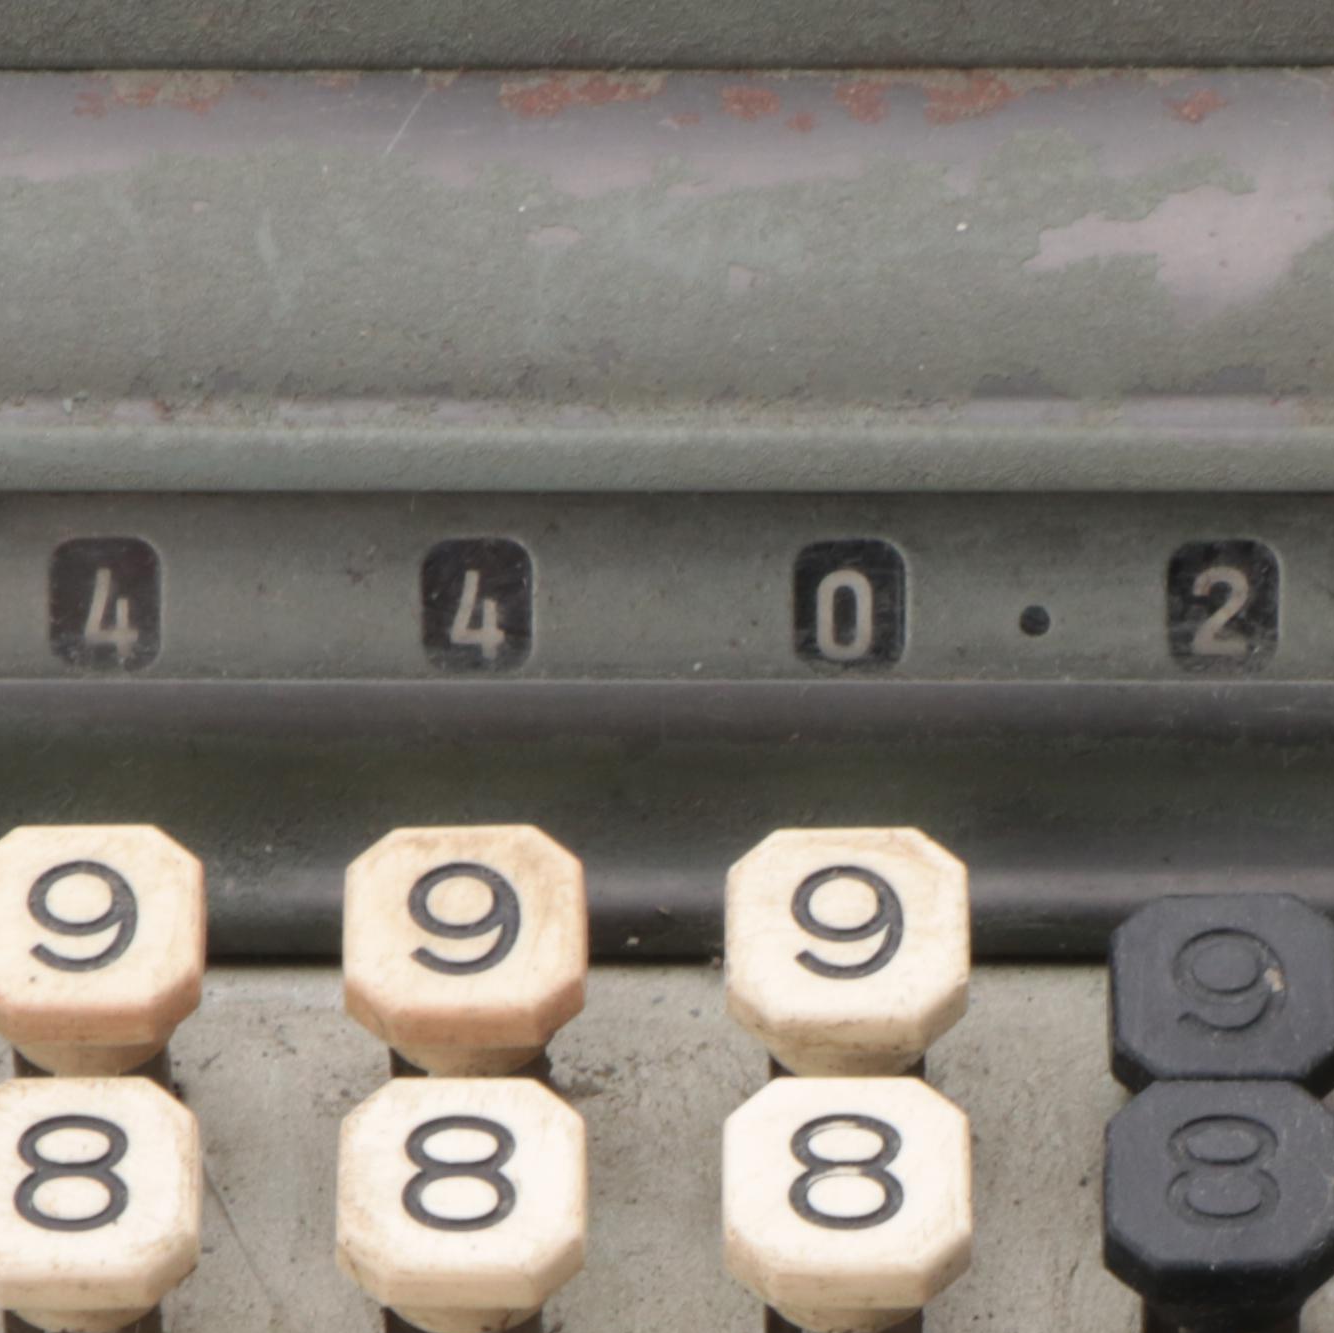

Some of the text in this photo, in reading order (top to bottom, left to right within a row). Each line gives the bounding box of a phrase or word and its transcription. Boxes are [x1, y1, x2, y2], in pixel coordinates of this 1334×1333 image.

[83, 567, 139, 661] 4
[450, 569, 507, 661] 4
[814, 567, 873, 663] 0
[1190, 565, 1251, 657] 2
[27, 859, 138, 972] 9
[407, 861, 521, 975] 9
[791, 865, 904, 979] 9
[1172, 927, 1286, 1030] 9
[14, 1114, 129, 1232] 8
[402, 1114, 516, 1232] 8
[788, 1113, 904, 1230] 8
